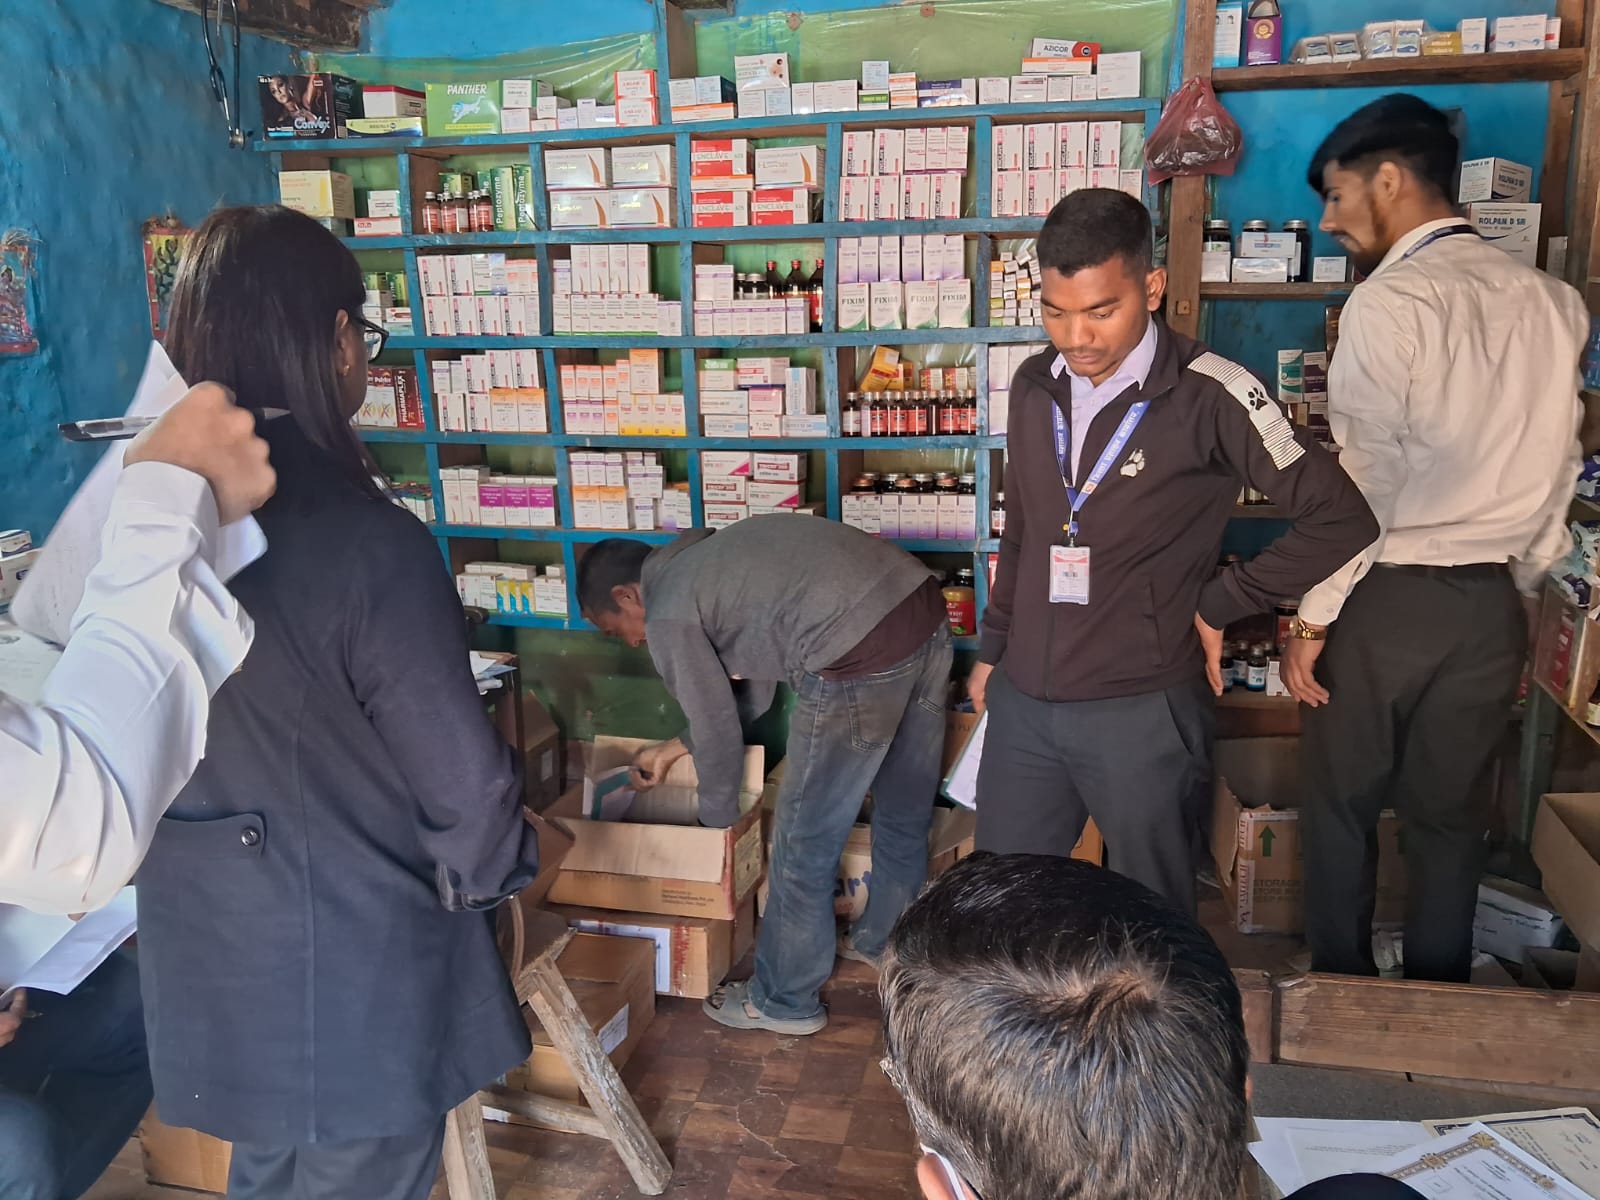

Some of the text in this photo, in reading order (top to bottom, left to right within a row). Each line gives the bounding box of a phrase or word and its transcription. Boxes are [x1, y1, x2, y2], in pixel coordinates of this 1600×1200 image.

[1043, 45, 1069, 53] AZICOR
[446, 84, 488, 96] PANTHER
[294, 117, 331, 134] Convex
[495, 176, 504, 224] Peptozyme
[518, 175, 527, 223] Peptozyme
[1478, 217, 1507, 225] ROLPAN
[1509, 217, 1515, 225] D
[398, 375, 408, 423] PHARMAPLEX
